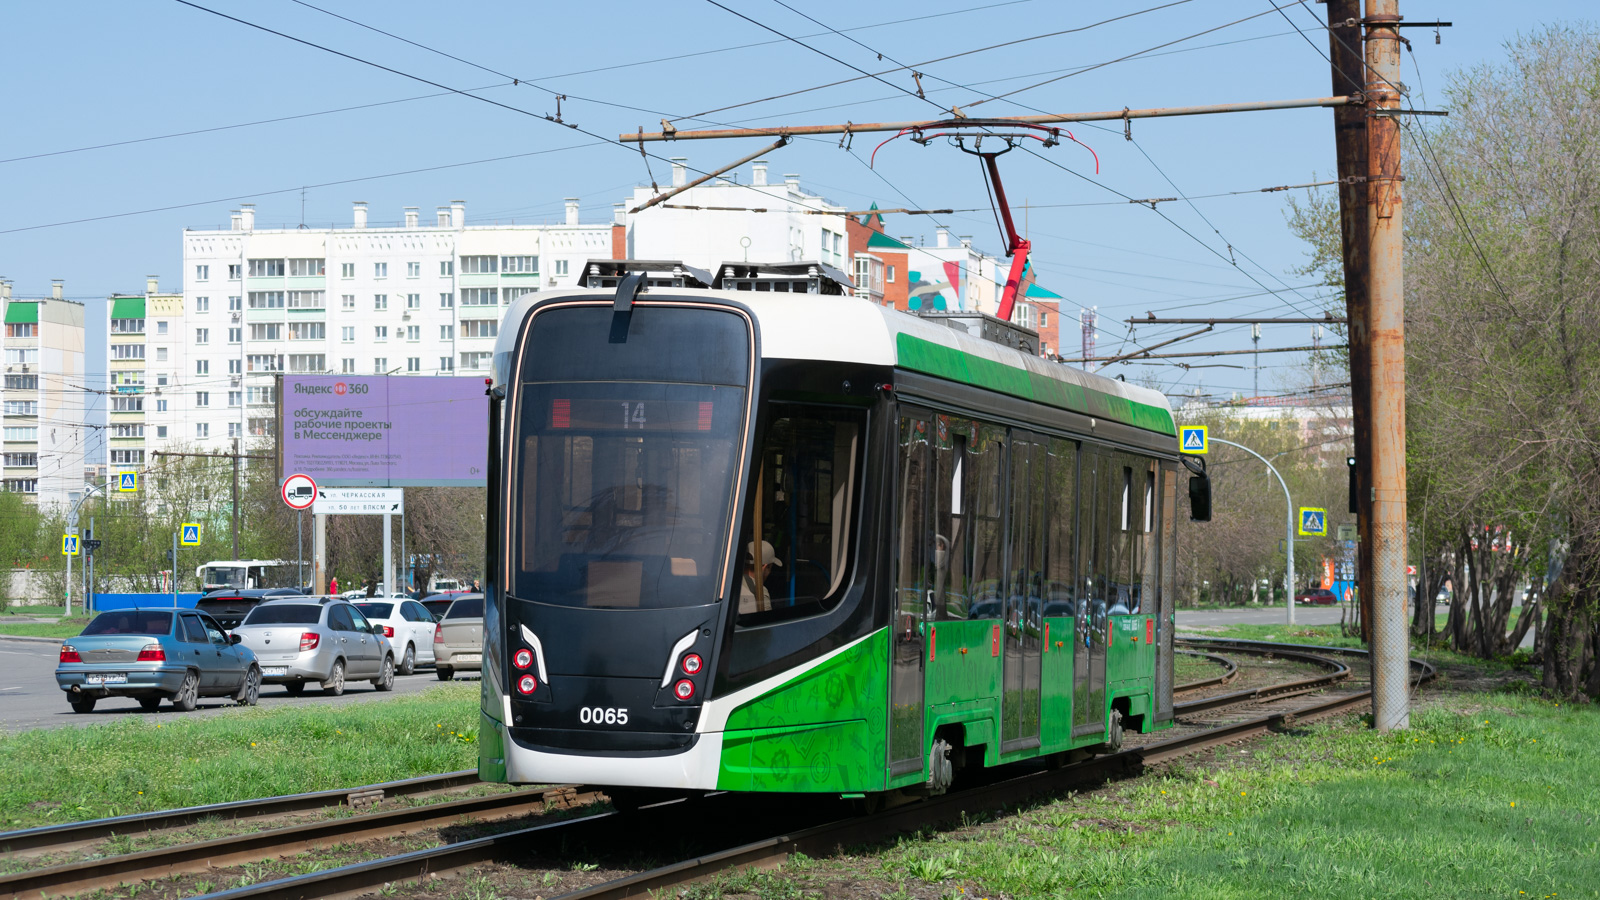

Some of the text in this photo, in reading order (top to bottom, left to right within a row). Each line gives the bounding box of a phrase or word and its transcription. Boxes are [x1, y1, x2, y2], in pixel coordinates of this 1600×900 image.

[294, 383, 368, 394] Яндекс 360
[294, 408, 362, 419] обсуждайте
[622, 402, 646, 429] 14
[294, 419, 392, 430] рабочие проекты
[304, 430, 382, 441] Мессенджере
[470, 466, 480, 475] 0+
[580, 707, 628, 724] 0065
